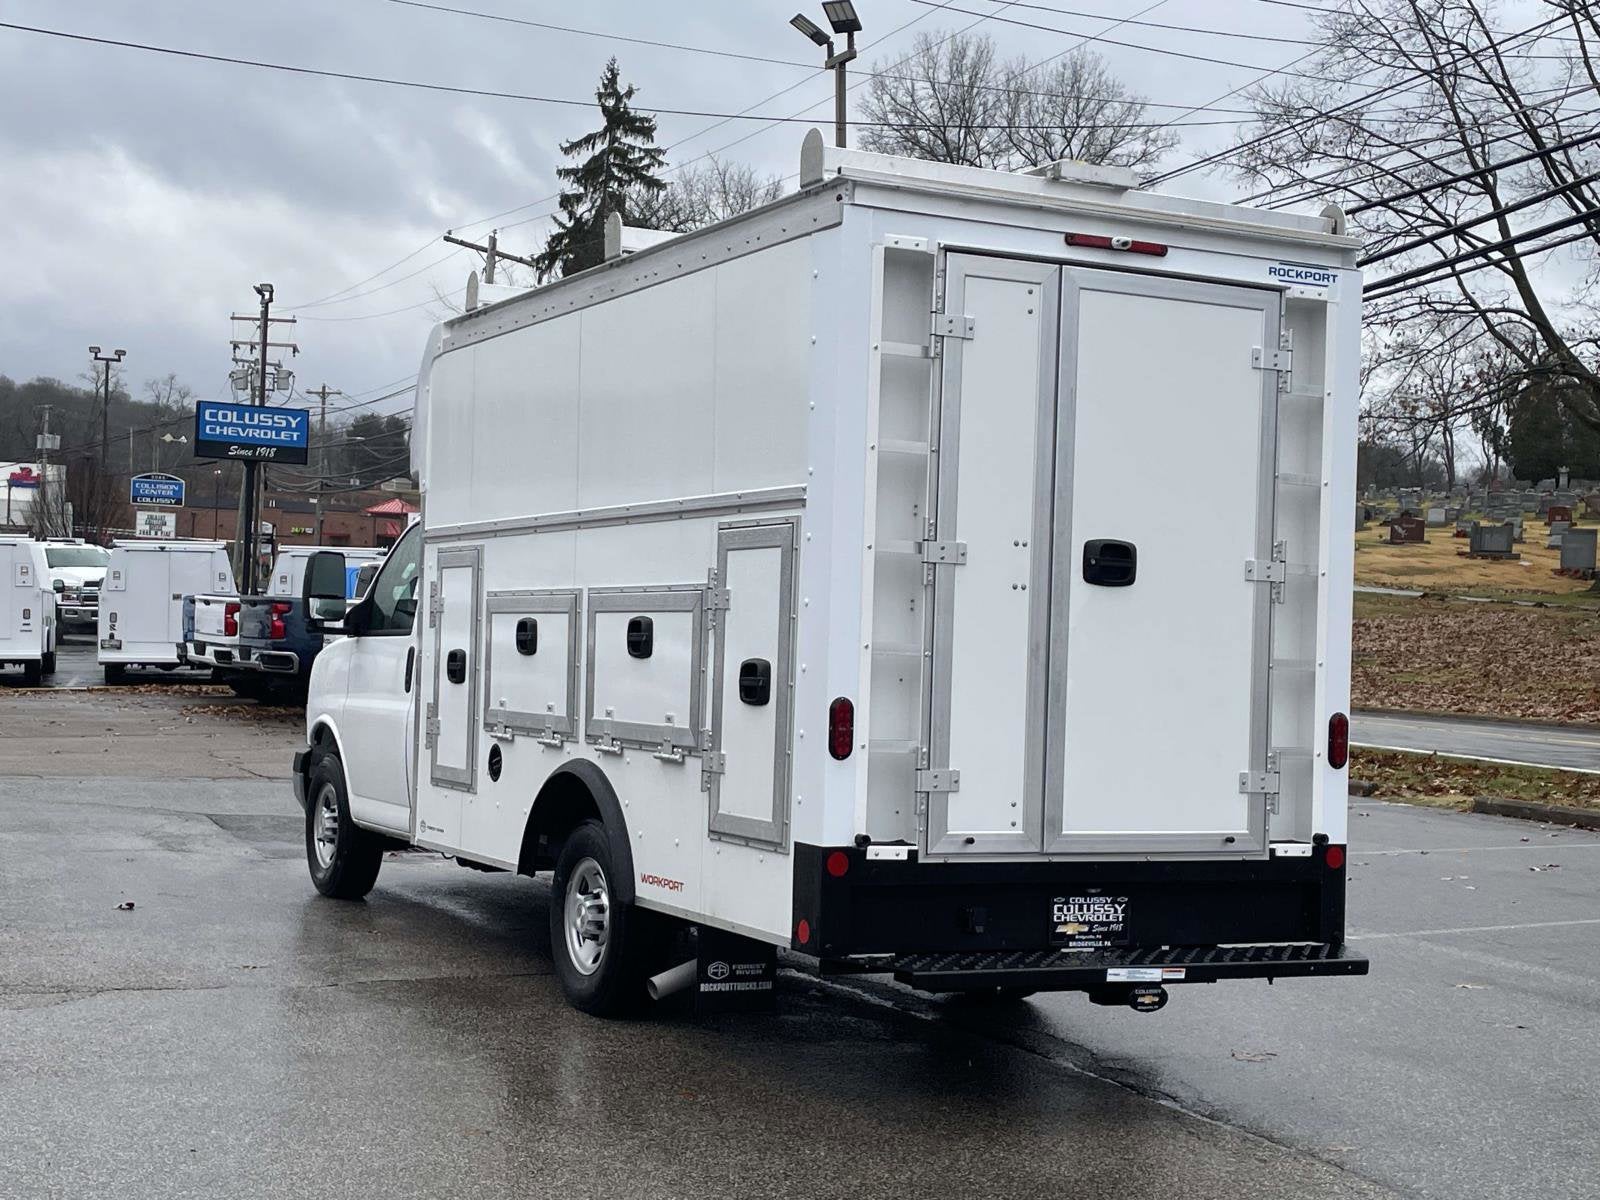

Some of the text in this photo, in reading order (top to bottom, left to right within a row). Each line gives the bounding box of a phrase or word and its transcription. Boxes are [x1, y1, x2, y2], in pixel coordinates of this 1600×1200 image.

[1268, 266, 1338, 284] ROCKPORT
[204, 408, 302, 428] COLUSSY
[205, 424, 300, 441] CHEVROLET
[228, 445, 277, 457] Since 1918
[135, 482, 179, 490] COLLISION
[136, 496, 177, 504] COLUSSY
[640, 873, 685, 892] WORKPORT
[1069, 896, 1112, 904] COLUSSY
[1053, 903, 1126, 915] COLUSSY
[1053, 913, 1125, 922] CHEVROLET
[1092, 923, 1108, 933] Since
[699, 981, 773, 992] ROCKPORTTRUCKS.COM
